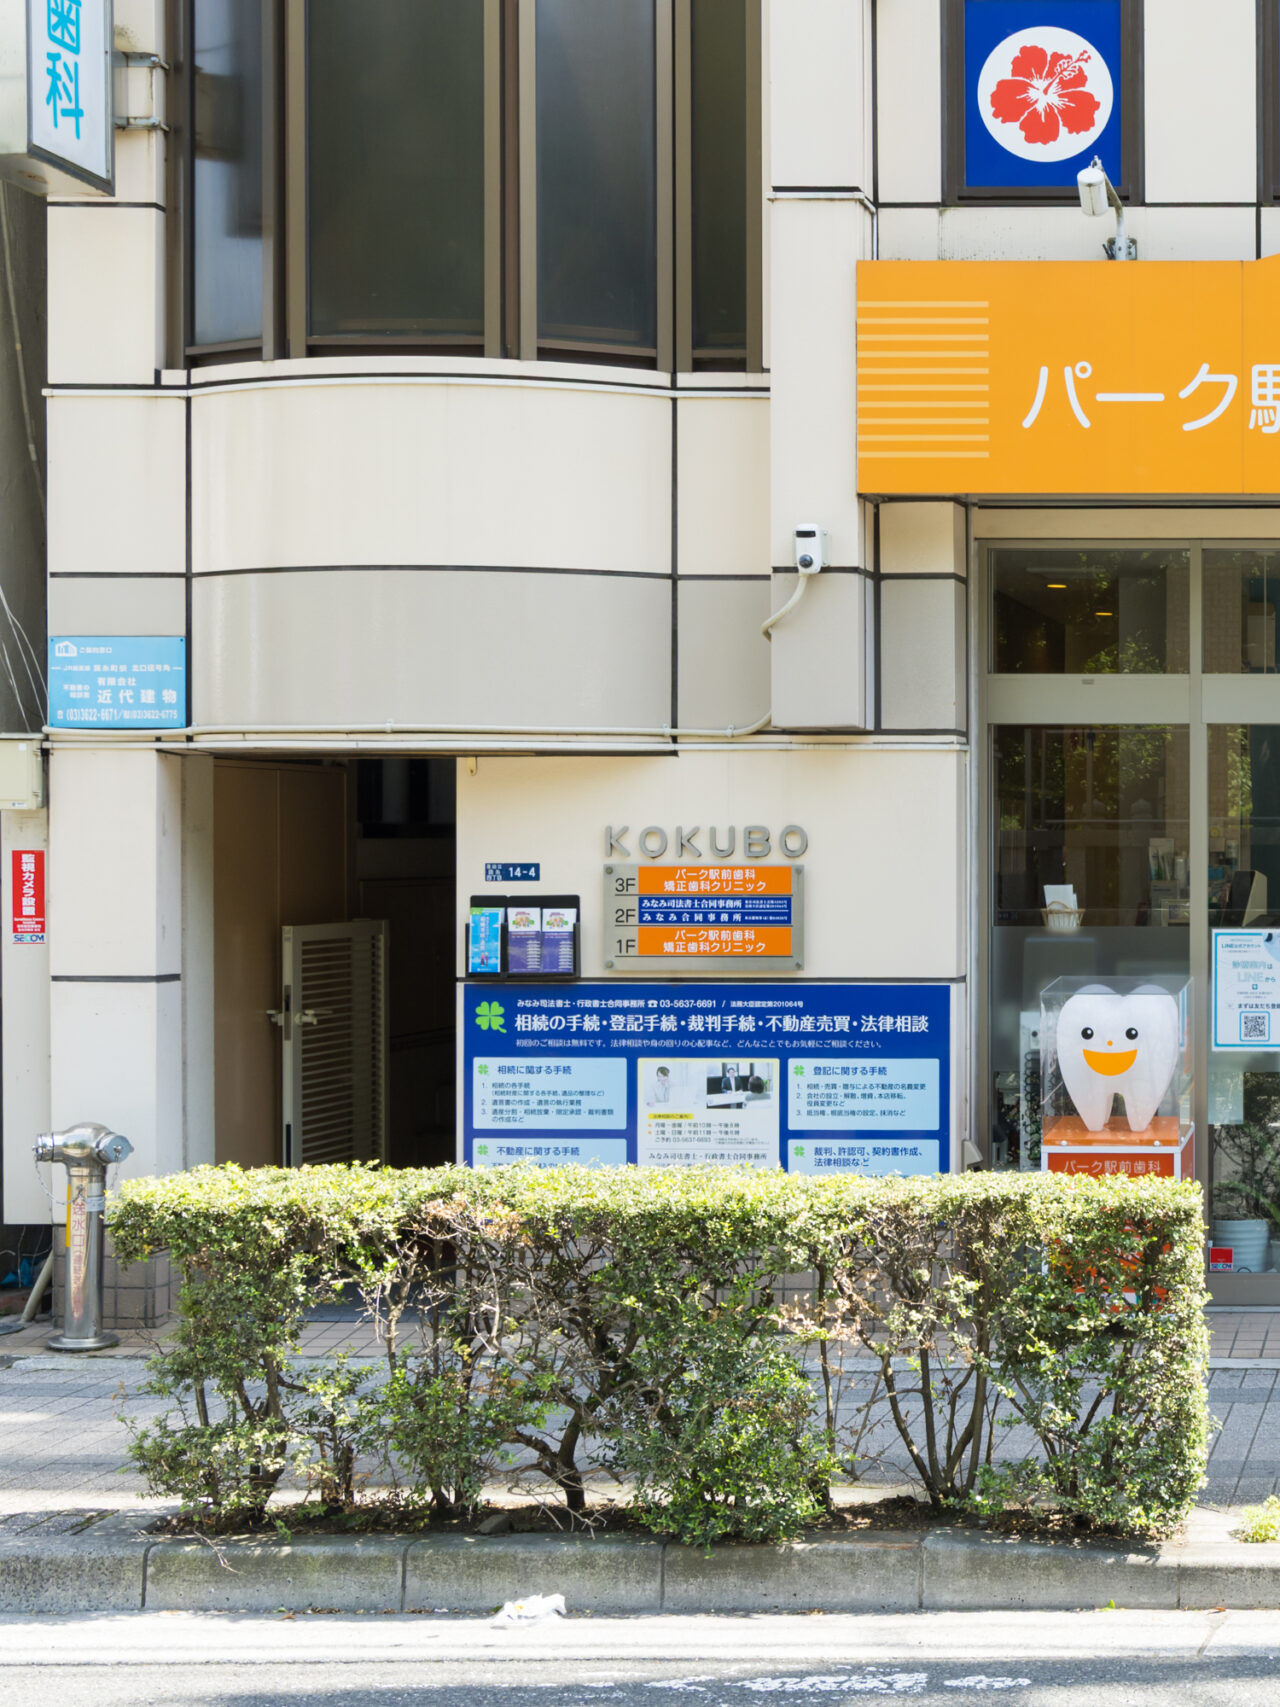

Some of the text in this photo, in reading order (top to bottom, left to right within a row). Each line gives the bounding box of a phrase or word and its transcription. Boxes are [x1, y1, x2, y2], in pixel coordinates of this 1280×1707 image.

[97, 689, 177, 704] 近代建物
[605, 825, 808, 858] KOKUBO
[508, 867, 536, 877] 14-4
[675, 869, 755, 880] パーク駅前歯科
[615, 878, 636, 892] 3F
[664, 881, 767, 892] 矯正歯科クリニック
[642, 899, 742, 908] みなみ司法書士合同事務所
[615, 909, 636, 923] 2F
[642, 913, 742, 922] みなみ合同事務所
[13, 934, 45, 942] SECOM
[675, 930, 755, 941] パーク駅前歯科
[616, 939, 636, 953] 1F
[663, 942, 766, 953] 矯正歯科クリニック
[517, 1000, 645, 1008] みなみ司法書士・行政書士合同事務所
[660, 1000, 716, 1008] 03-5637-6691
[514, 1014, 929, 1033] 相続の手続・登記手続・裁判手続・不動産売買・法律相談
[497, 1065, 572, 1075] 相続に関する手続
[813, 1066, 887, 1076] 登記に関する手続
[496, 1147, 580, 1156] 不動産に関する手続
[814, 1157, 870, 1167] 法律相談など
[1064, 1160, 1161, 1174] パーク駅前歯科
